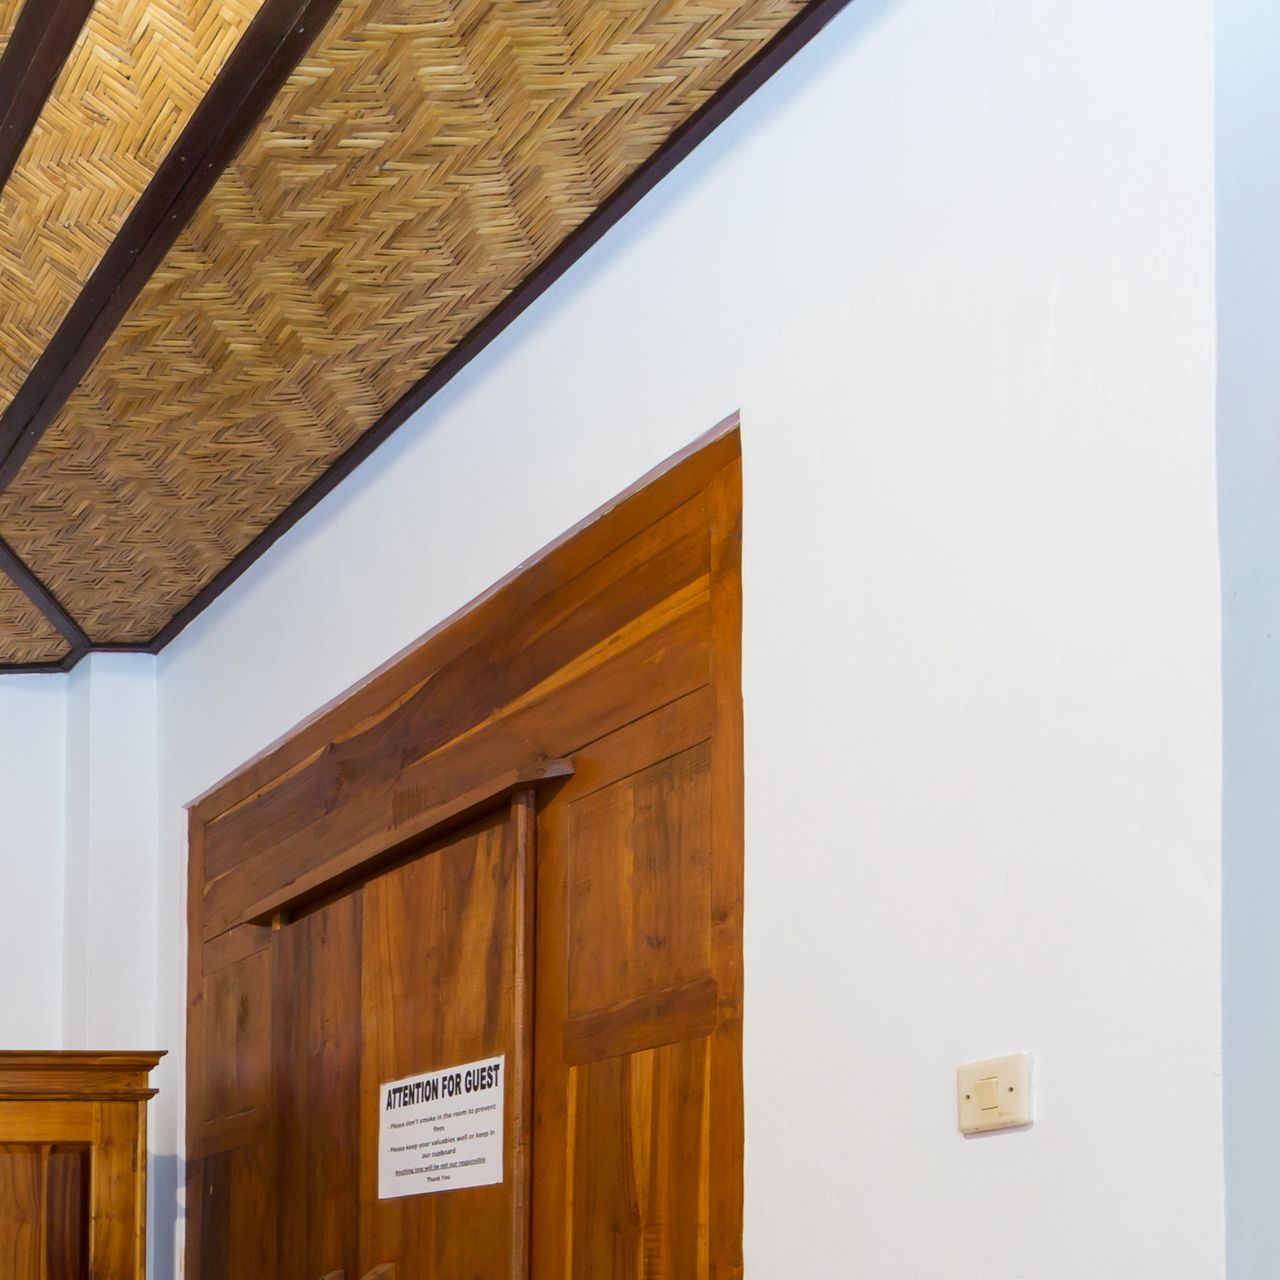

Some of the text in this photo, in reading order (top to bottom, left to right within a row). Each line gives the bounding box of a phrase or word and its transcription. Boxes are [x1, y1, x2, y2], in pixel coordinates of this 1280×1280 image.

[386, 1064, 500, 1110] ATTENTION FOR GUEST
[419, 1142, 430, 1150] your
